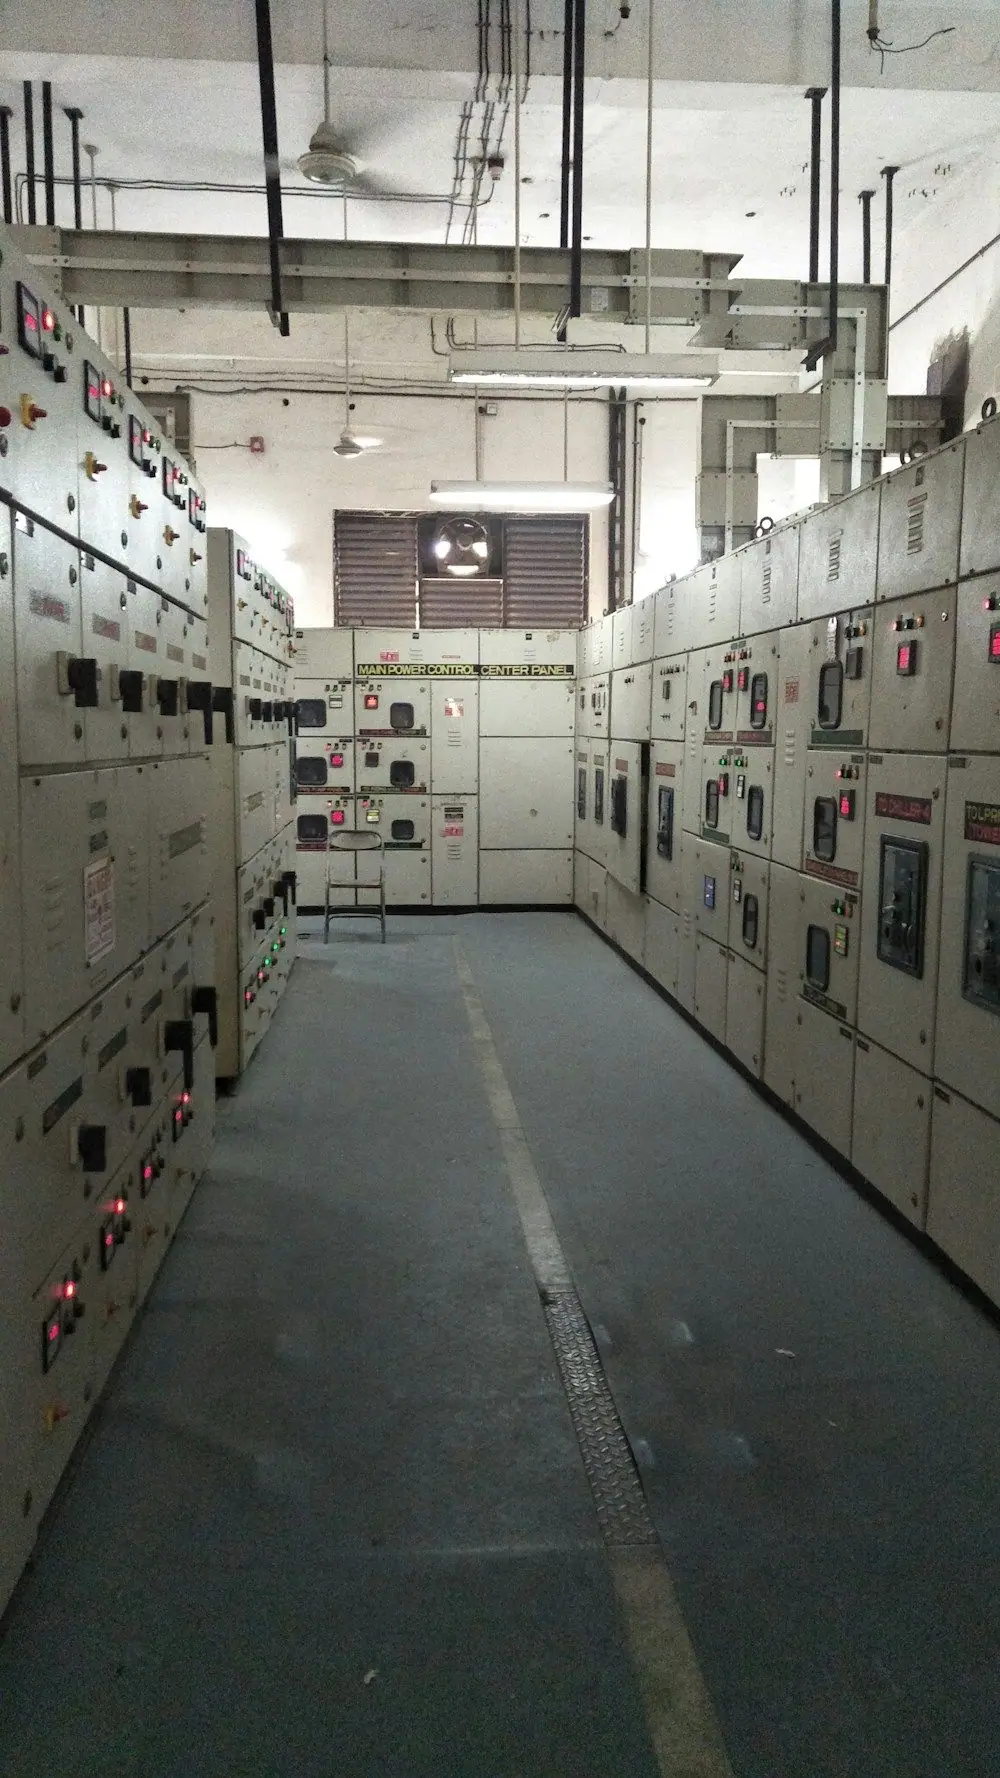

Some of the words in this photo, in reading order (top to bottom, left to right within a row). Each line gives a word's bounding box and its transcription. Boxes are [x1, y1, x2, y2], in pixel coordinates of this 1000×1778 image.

[359, 664, 387, 675] MAIN
[388, 664, 427, 675] POWER
[427, 664, 478, 675] CONTROL
[480, 665, 529, 676] CENTER
[531, 665, 573, 676] PANEL
